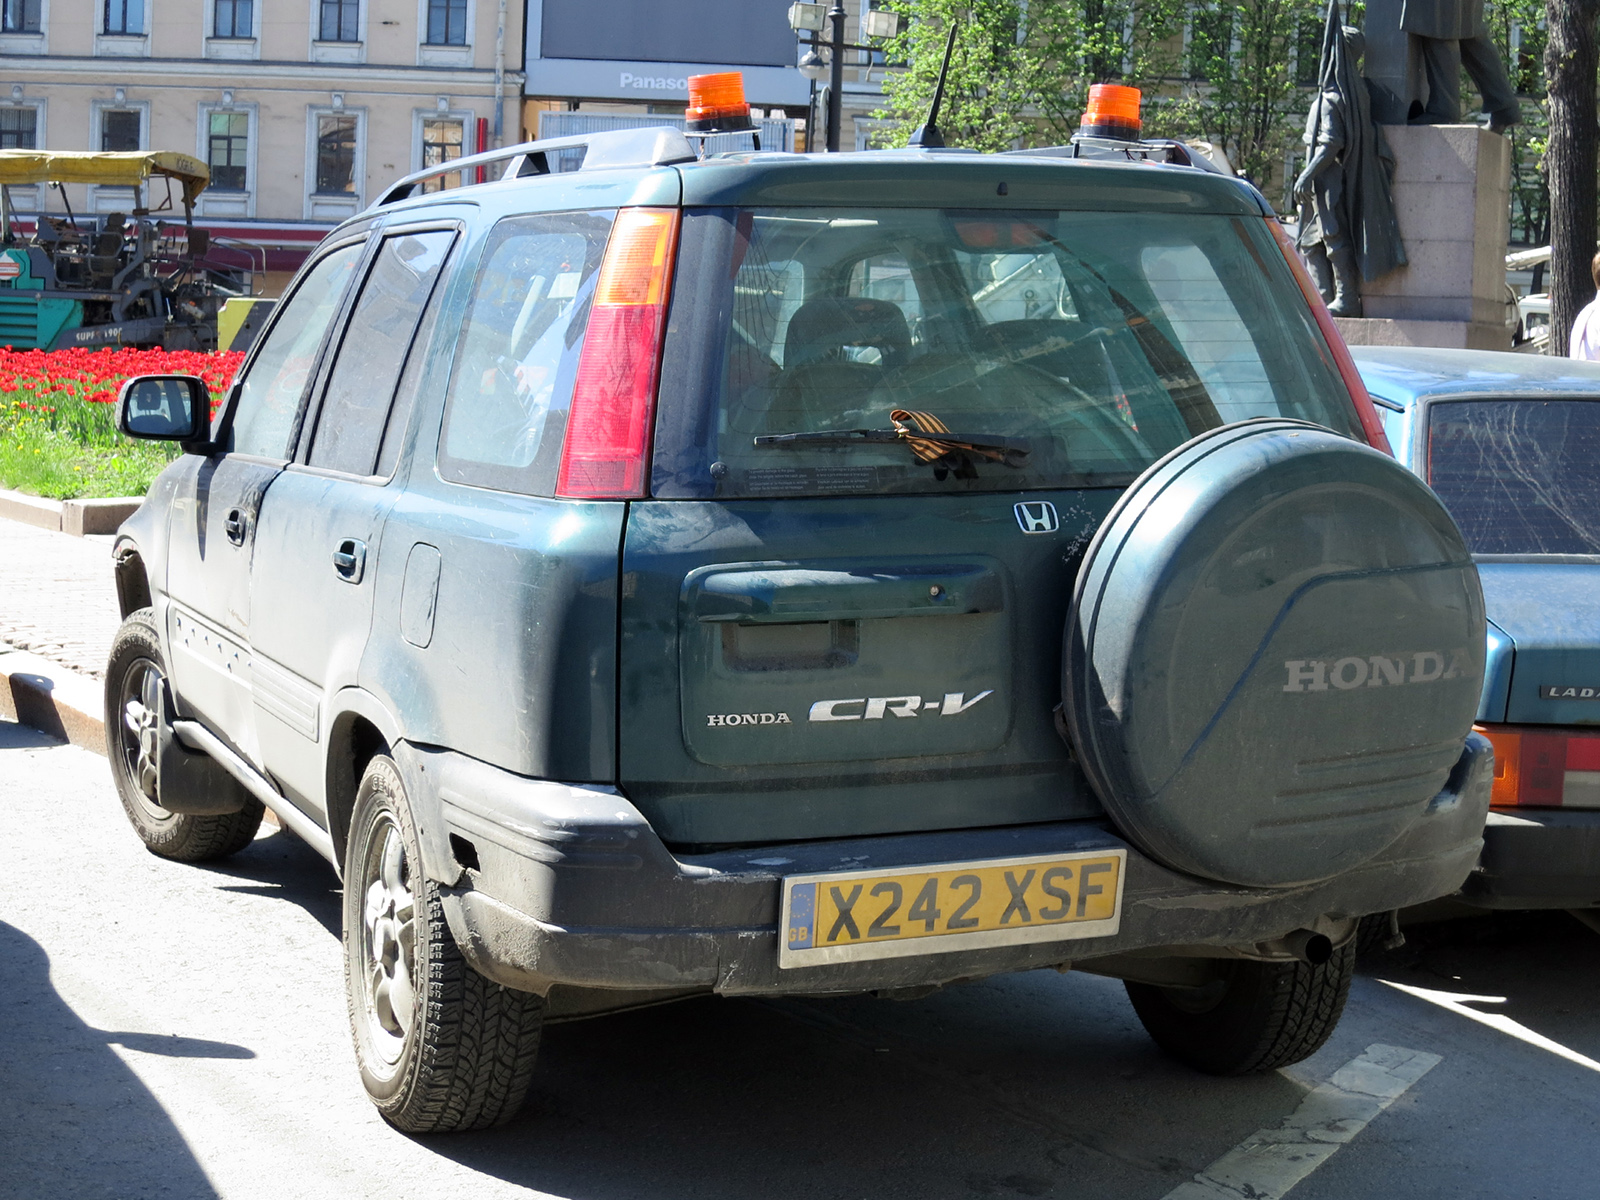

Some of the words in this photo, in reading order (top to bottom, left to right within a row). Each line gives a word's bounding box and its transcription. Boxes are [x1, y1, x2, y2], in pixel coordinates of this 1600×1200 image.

[1283, 648, 1477, 692] HONDA
[706, 711, 792, 728] HONDA
[808, 689, 995, 723] CR-V
[826, 874, 983, 942] X242
[999, 862, 1113, 926] XSF
[788, 926, 808, 943] GB
